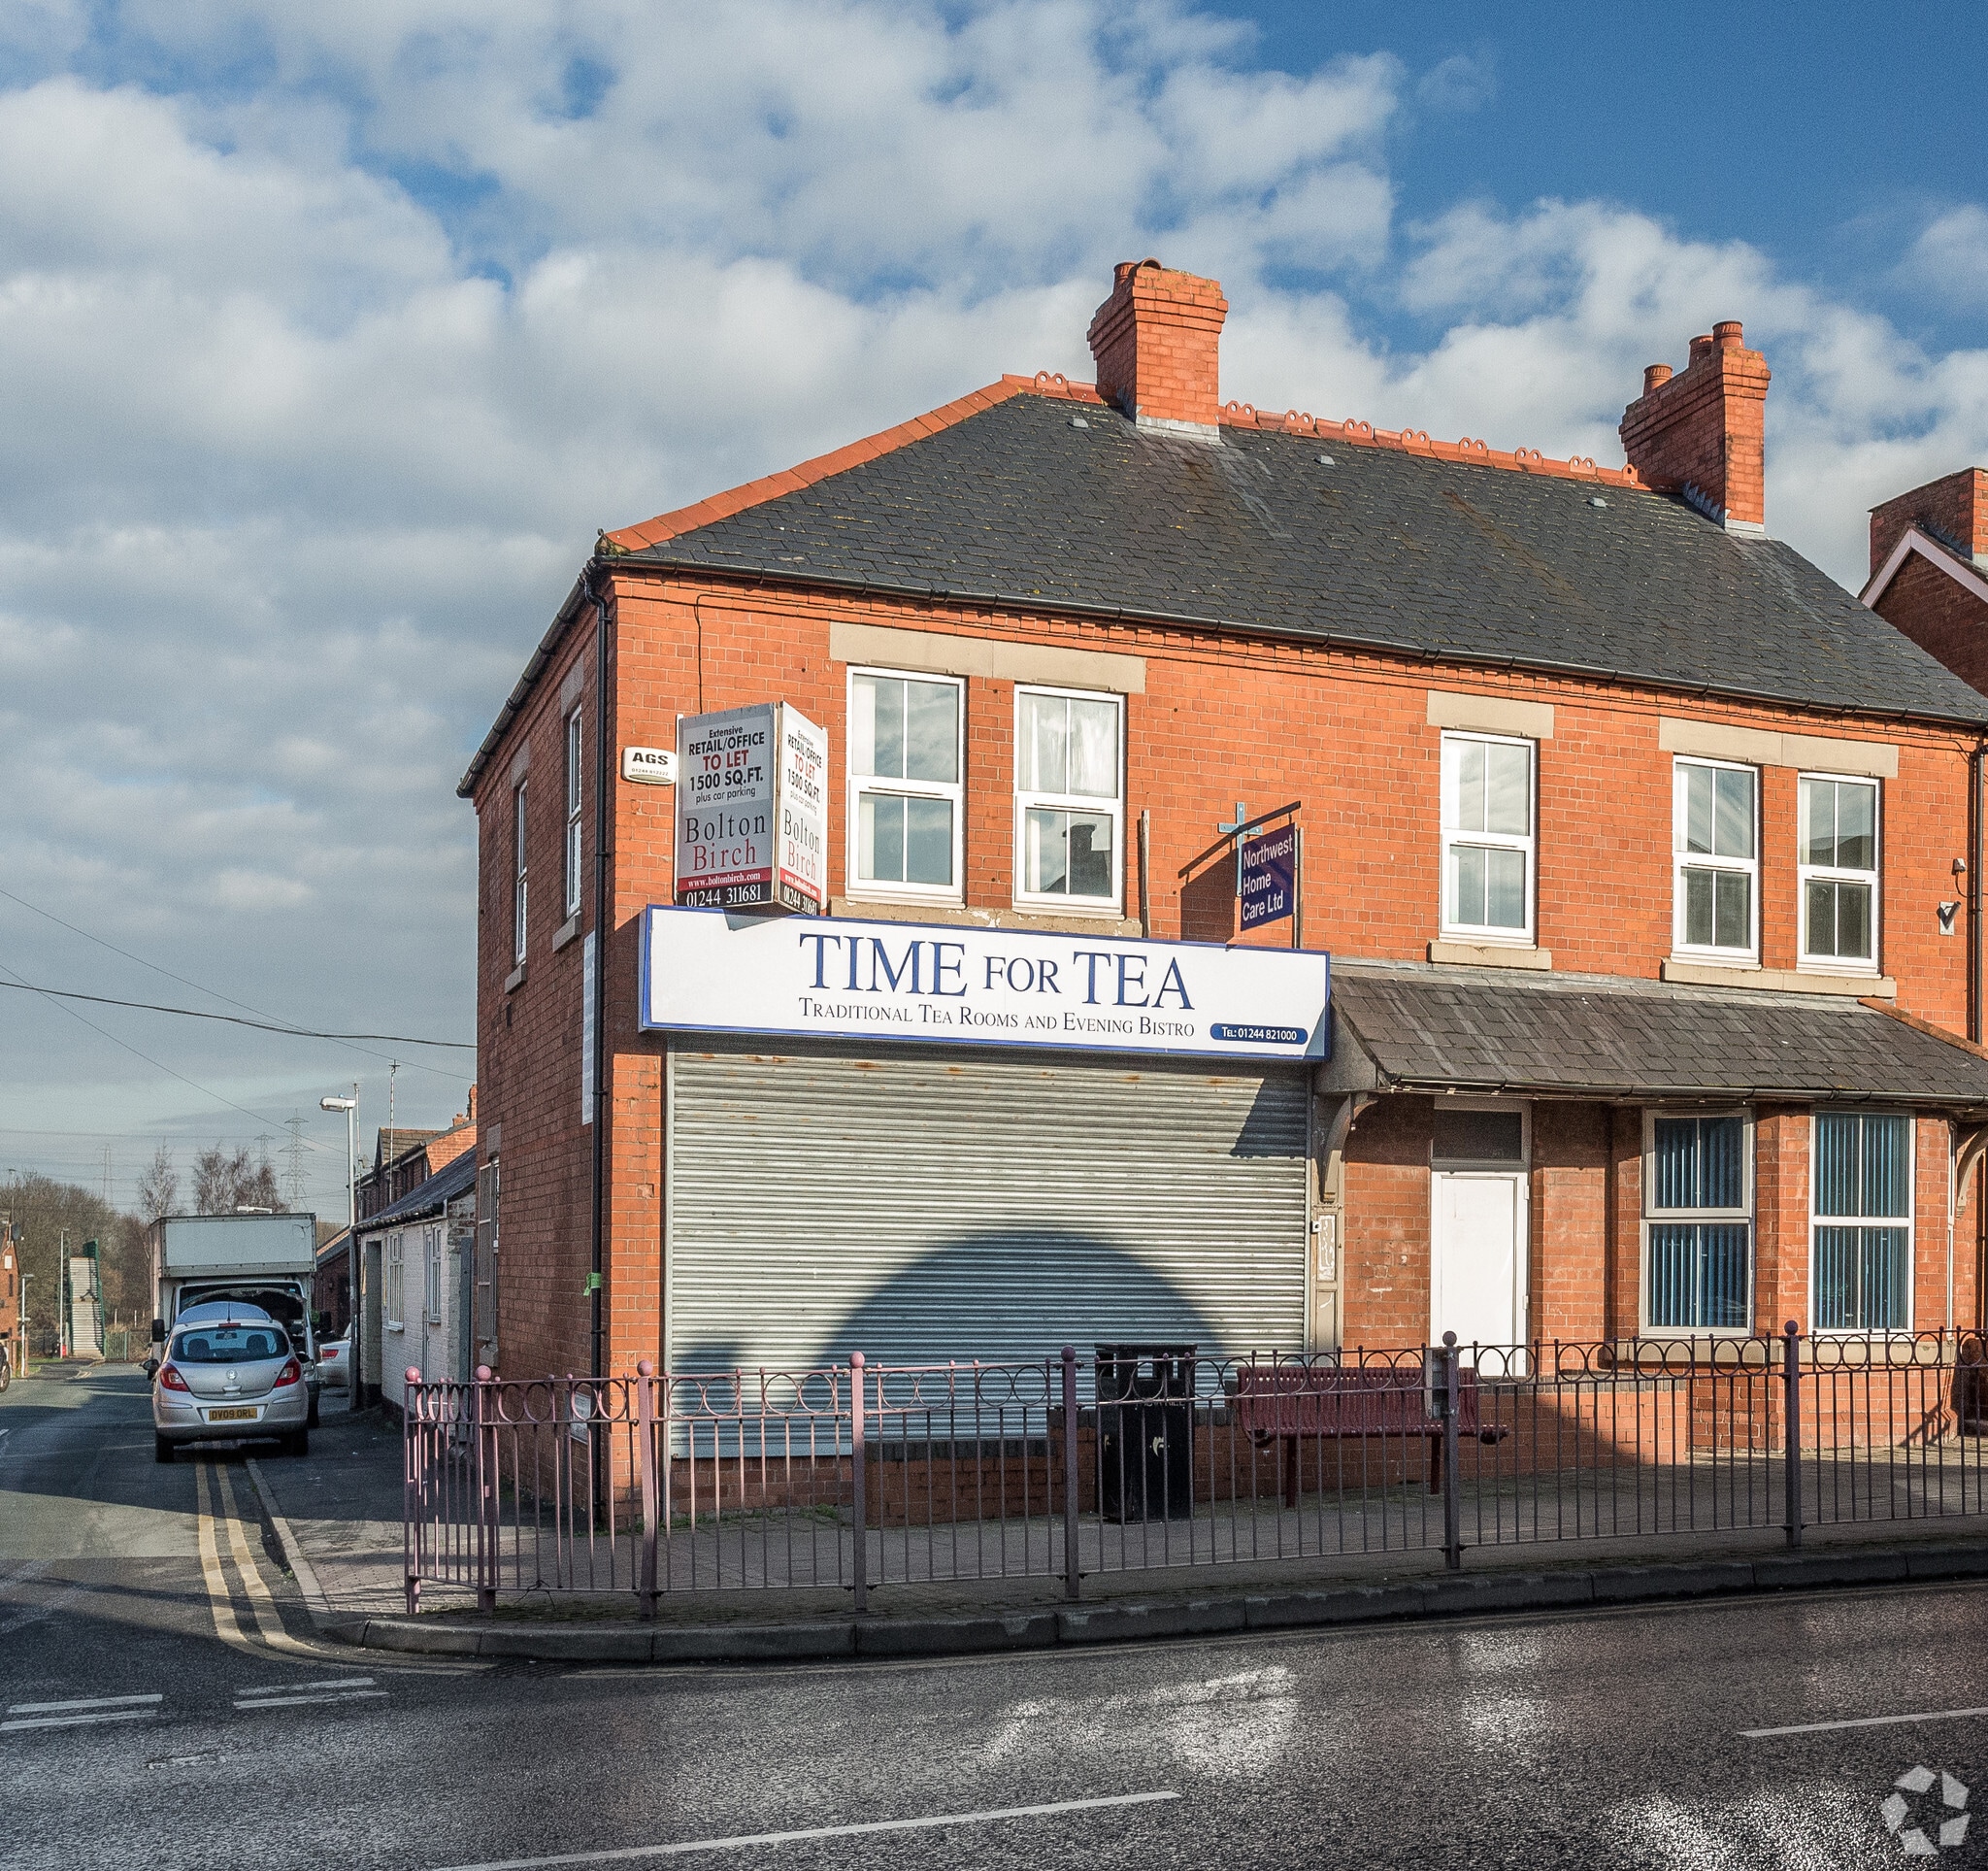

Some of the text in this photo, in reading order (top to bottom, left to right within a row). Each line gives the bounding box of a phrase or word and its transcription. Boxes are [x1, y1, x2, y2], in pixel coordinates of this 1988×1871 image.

[688, 731, 765, 755] RETAIL/OFFICE
[709, 725, 744, 739] Extensive
[632, 752, 669, 765] AGS
[703, 749, 749, 772] TO LET
[794, 753, 815, 782] TO LET
[689, 766, 764, 792] 1500 SQ.FT.
[787, 768, 803, 790] 1500
[696, 785, 756, 806] plus car parking
[684, 812, 766, 844] Bolton
[783, 808, 820, 854] Bolton
[692, 838, 757, 872] Birch
[787, 840, 816, 881] Birch
[1243, 834, 1292, 869] Northwest
[687, 872, 761, 888] www.boltonbirch.com
[1243, 873, 1271, 895] Home
[685, 884, 762, 908] 01244 311681
[783, 885, 801, 909] 01244
[1242, 889, 1284, 921] Care Ltd
[799, 932, 1195, 1011] TIME FOR TEA
[1238, 1028, 1264, 1040] 01244
[1265, 1029, 1297, 1041] 821000
